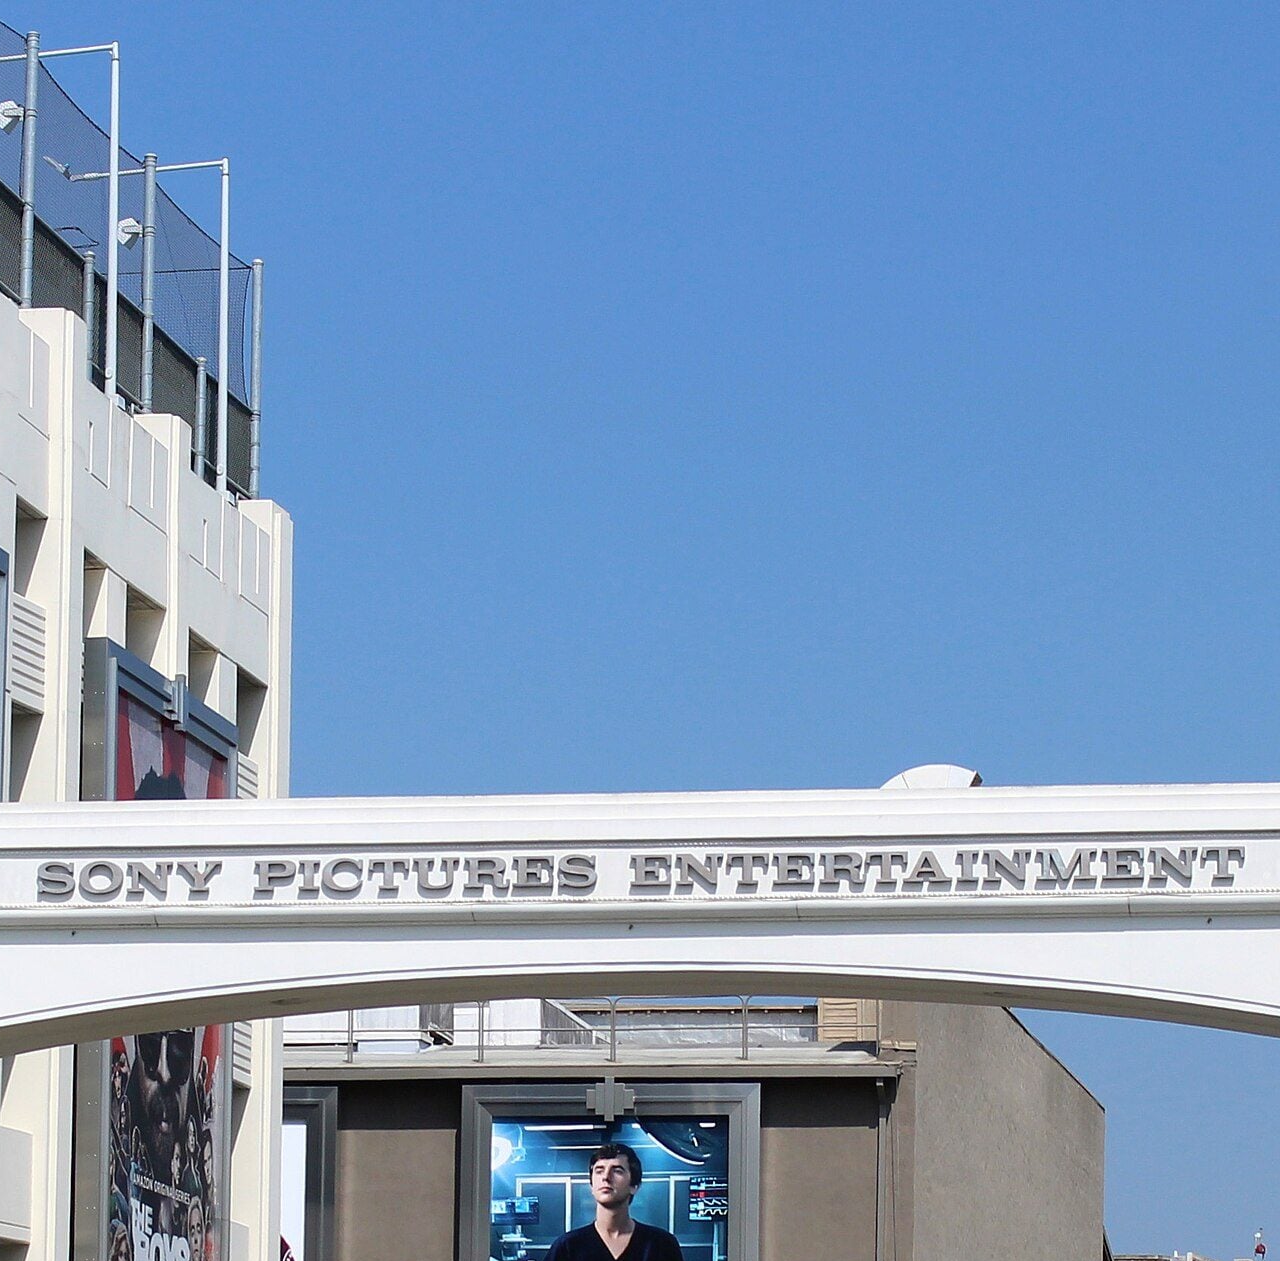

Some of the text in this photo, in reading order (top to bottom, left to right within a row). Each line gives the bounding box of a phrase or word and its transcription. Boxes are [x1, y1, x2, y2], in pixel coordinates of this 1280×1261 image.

[36, 846, 1247, 898] SONY PICTURES ENTERTAINMENT
[131, 1198, 153, 1236] THE
